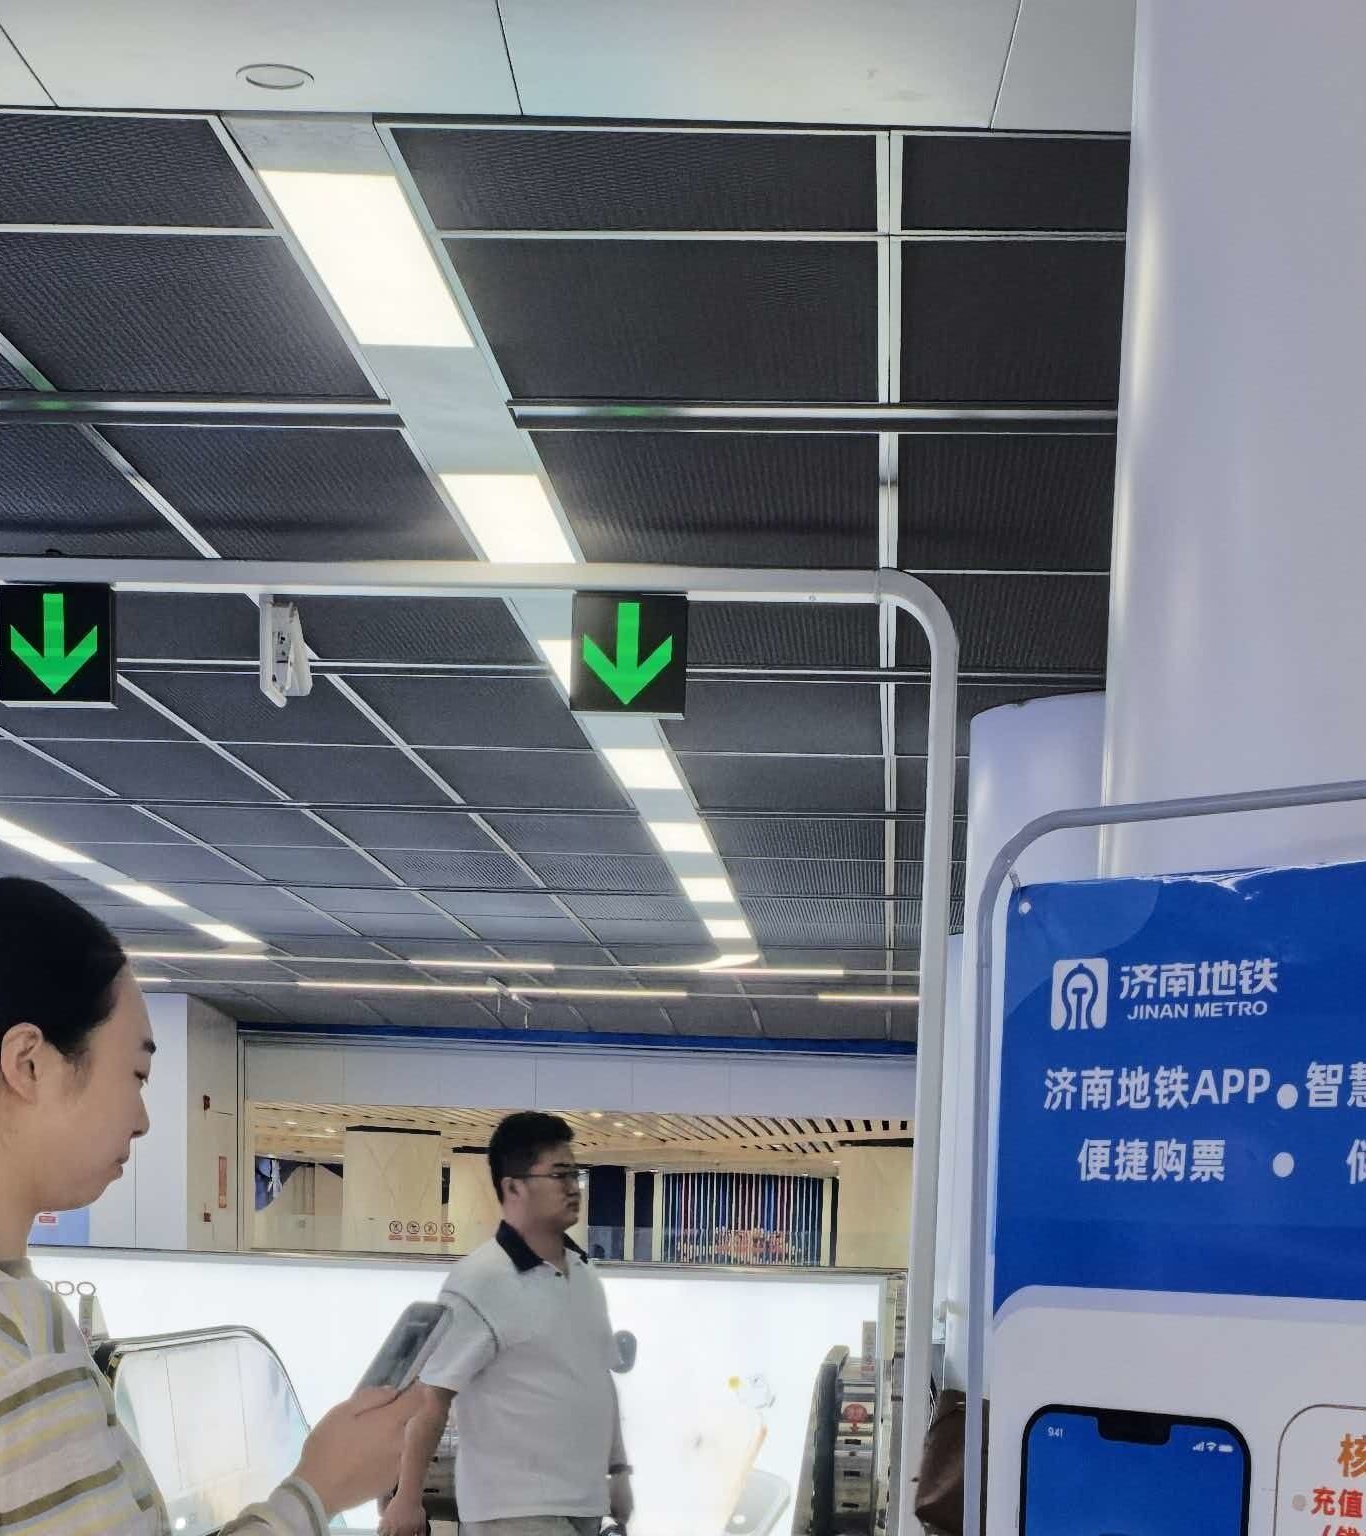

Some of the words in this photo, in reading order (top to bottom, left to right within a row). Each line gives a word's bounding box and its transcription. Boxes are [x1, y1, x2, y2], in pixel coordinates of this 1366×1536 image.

[1120, 958, 1278, 999] 济南地铁
[1127, 1003, 1188, 1020] JINAN
[1193, 1000, 1269, 1019] METRO
[1077, 1138, 1226, 1182] 便捷购票
